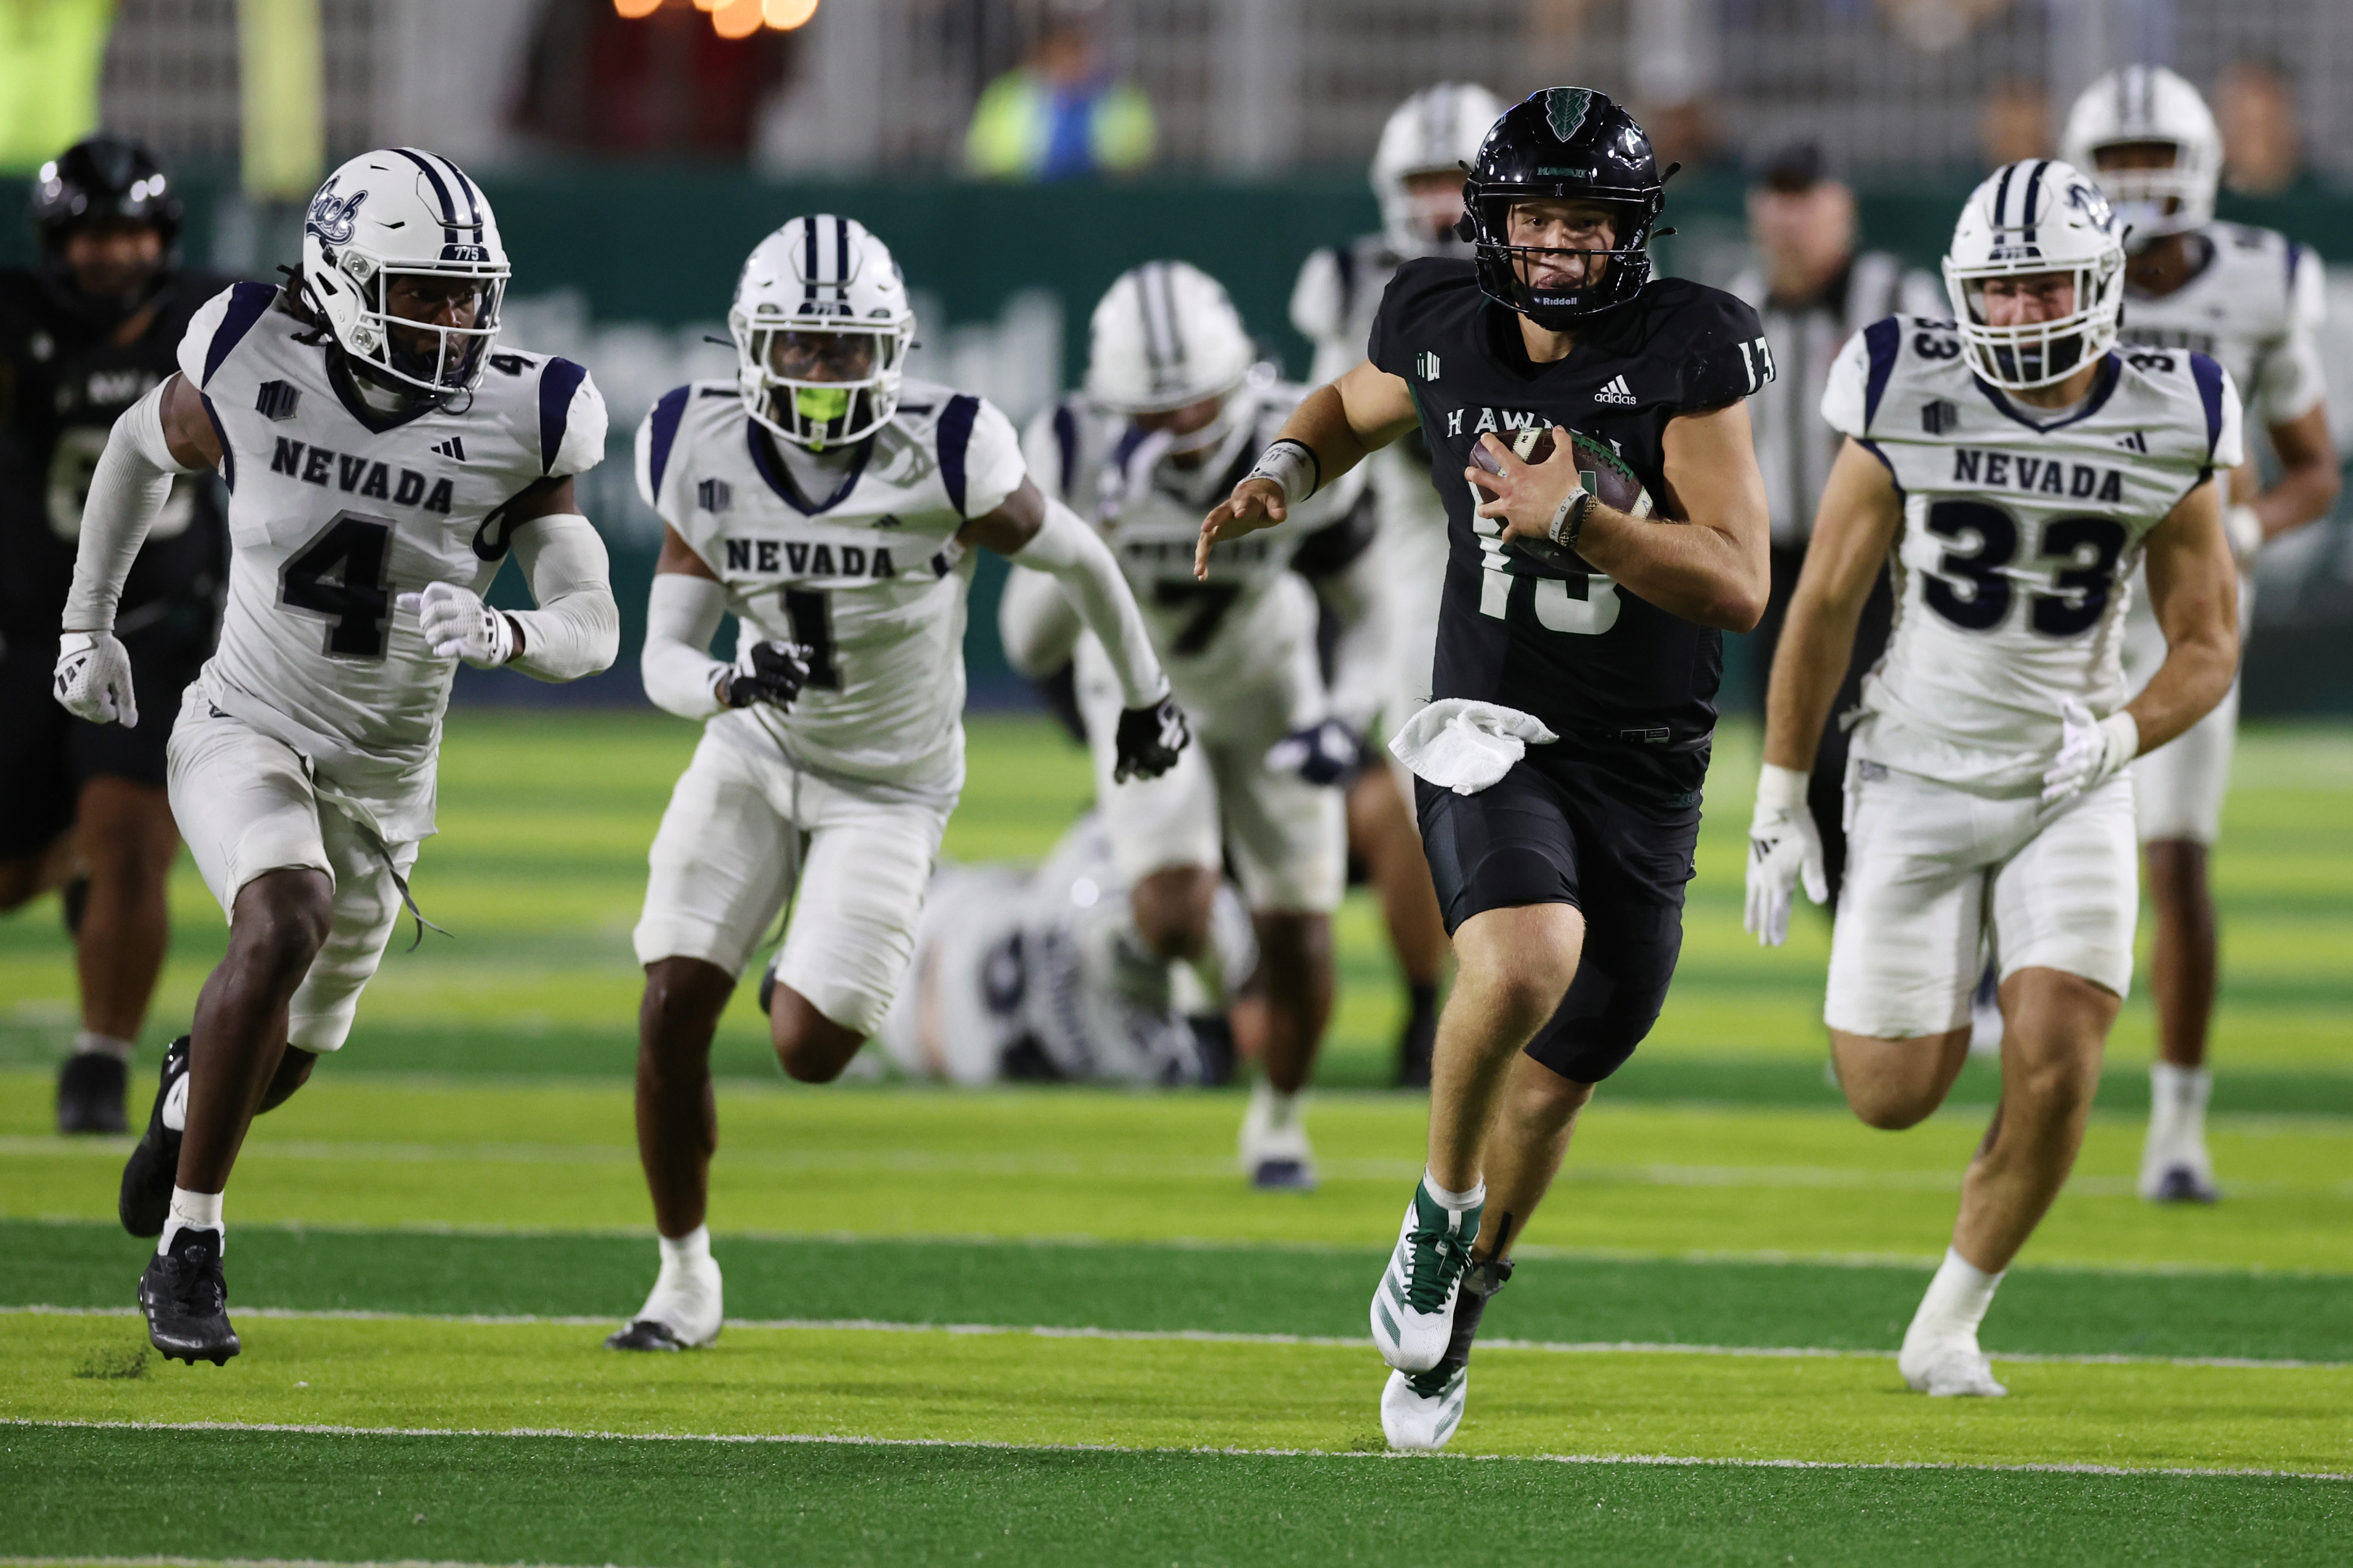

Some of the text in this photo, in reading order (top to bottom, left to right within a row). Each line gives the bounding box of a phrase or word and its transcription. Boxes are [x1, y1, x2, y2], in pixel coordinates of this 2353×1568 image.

[454, 246, 479, 261] 775
[1543, 297, 1577, 306] Riddell
[1594, 392, 1636, 405] adidas
[270, 435, 454, 514] NEVADA
[1953, 448, 2121, 503] NEVADA
[274, 509, 396, 661] 4
[726, 539, 895, 577] NEVADA
[1921, 498, 2129, 640] 33
[779, 587, 844, 693] 1
[1153, 576, 1244, 658] 7
